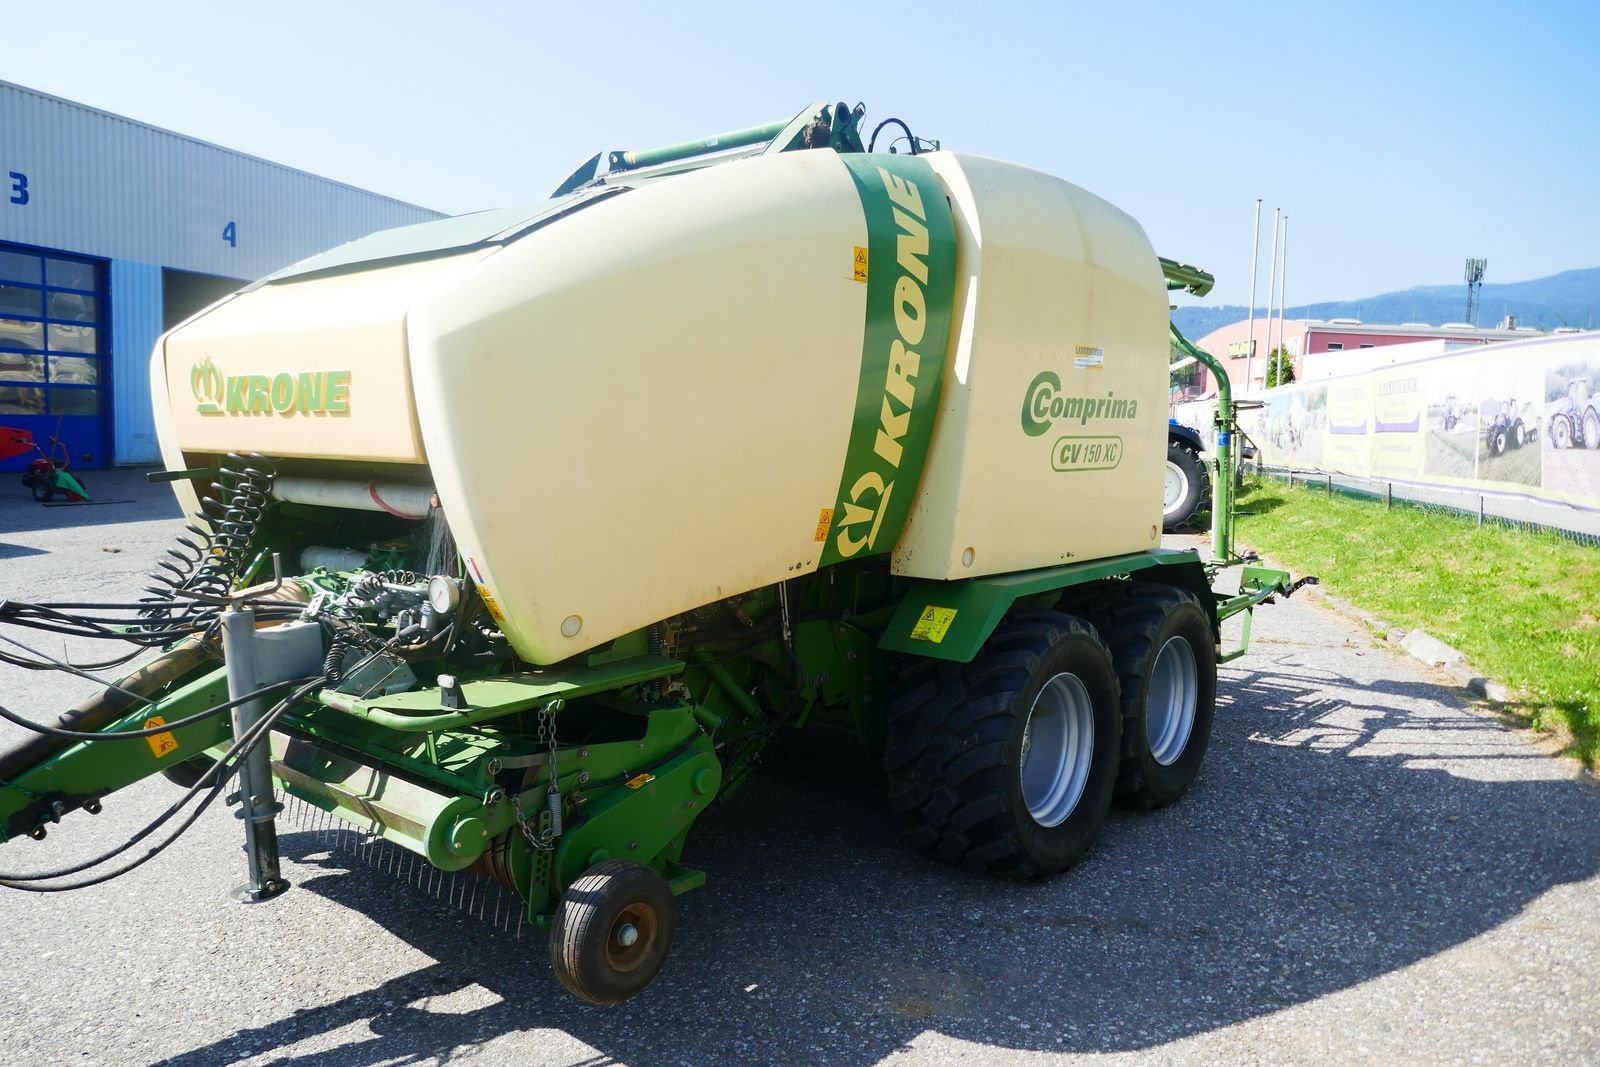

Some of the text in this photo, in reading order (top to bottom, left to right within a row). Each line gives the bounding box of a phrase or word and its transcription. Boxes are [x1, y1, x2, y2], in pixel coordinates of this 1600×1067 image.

[9, 171, 30, 206] 3
[222, 221, 237, 247] 4
[873, 166, 930, 469] KRONE
[226, 370, 351, 416] KRONE
[1021, 371, 1138, 437] Comprima
[1059, 443, 1118, 464] CV 150 XC
